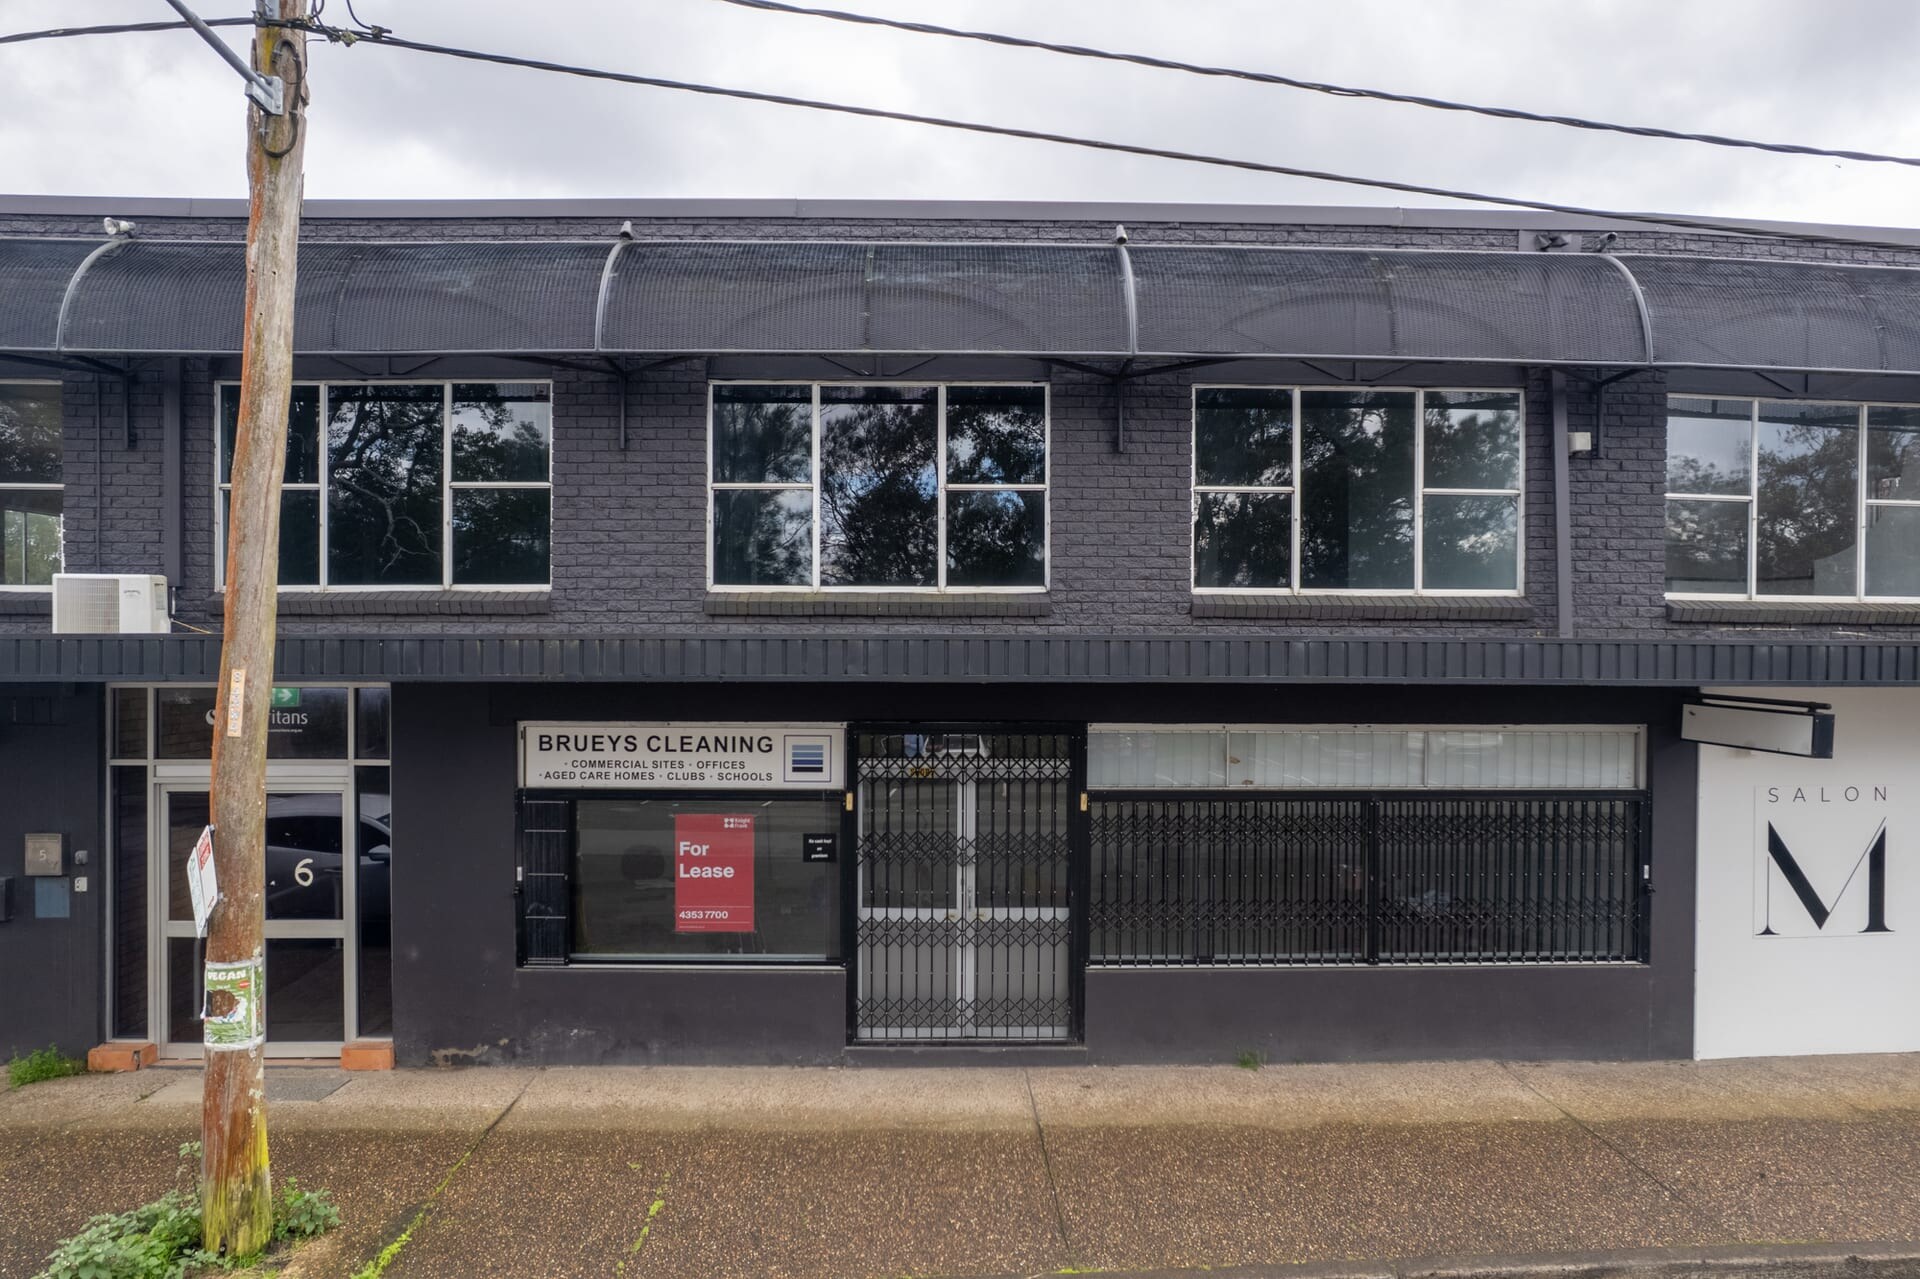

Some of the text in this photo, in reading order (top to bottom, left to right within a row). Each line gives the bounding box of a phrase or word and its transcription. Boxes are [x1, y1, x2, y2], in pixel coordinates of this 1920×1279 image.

[538, 734, 774, 754] BRUEYS CLEANING
[571, 759, 746, 770] COMMERCIAL SITES OFFICES
[544, 771, 773, 781] AGED CARE HOMES CLUBS SCHOOLS
[1768, 786, 1888, 803] SALON
[39, 849, 48, 861] 5
[679, 841, 710, 857] For
[294, 858, 314, 887] 6
[679, 863, 735, 879] Lease
[1755, 816, 1896, 936] M
[679, 910, 729, 919] 4353 7700
